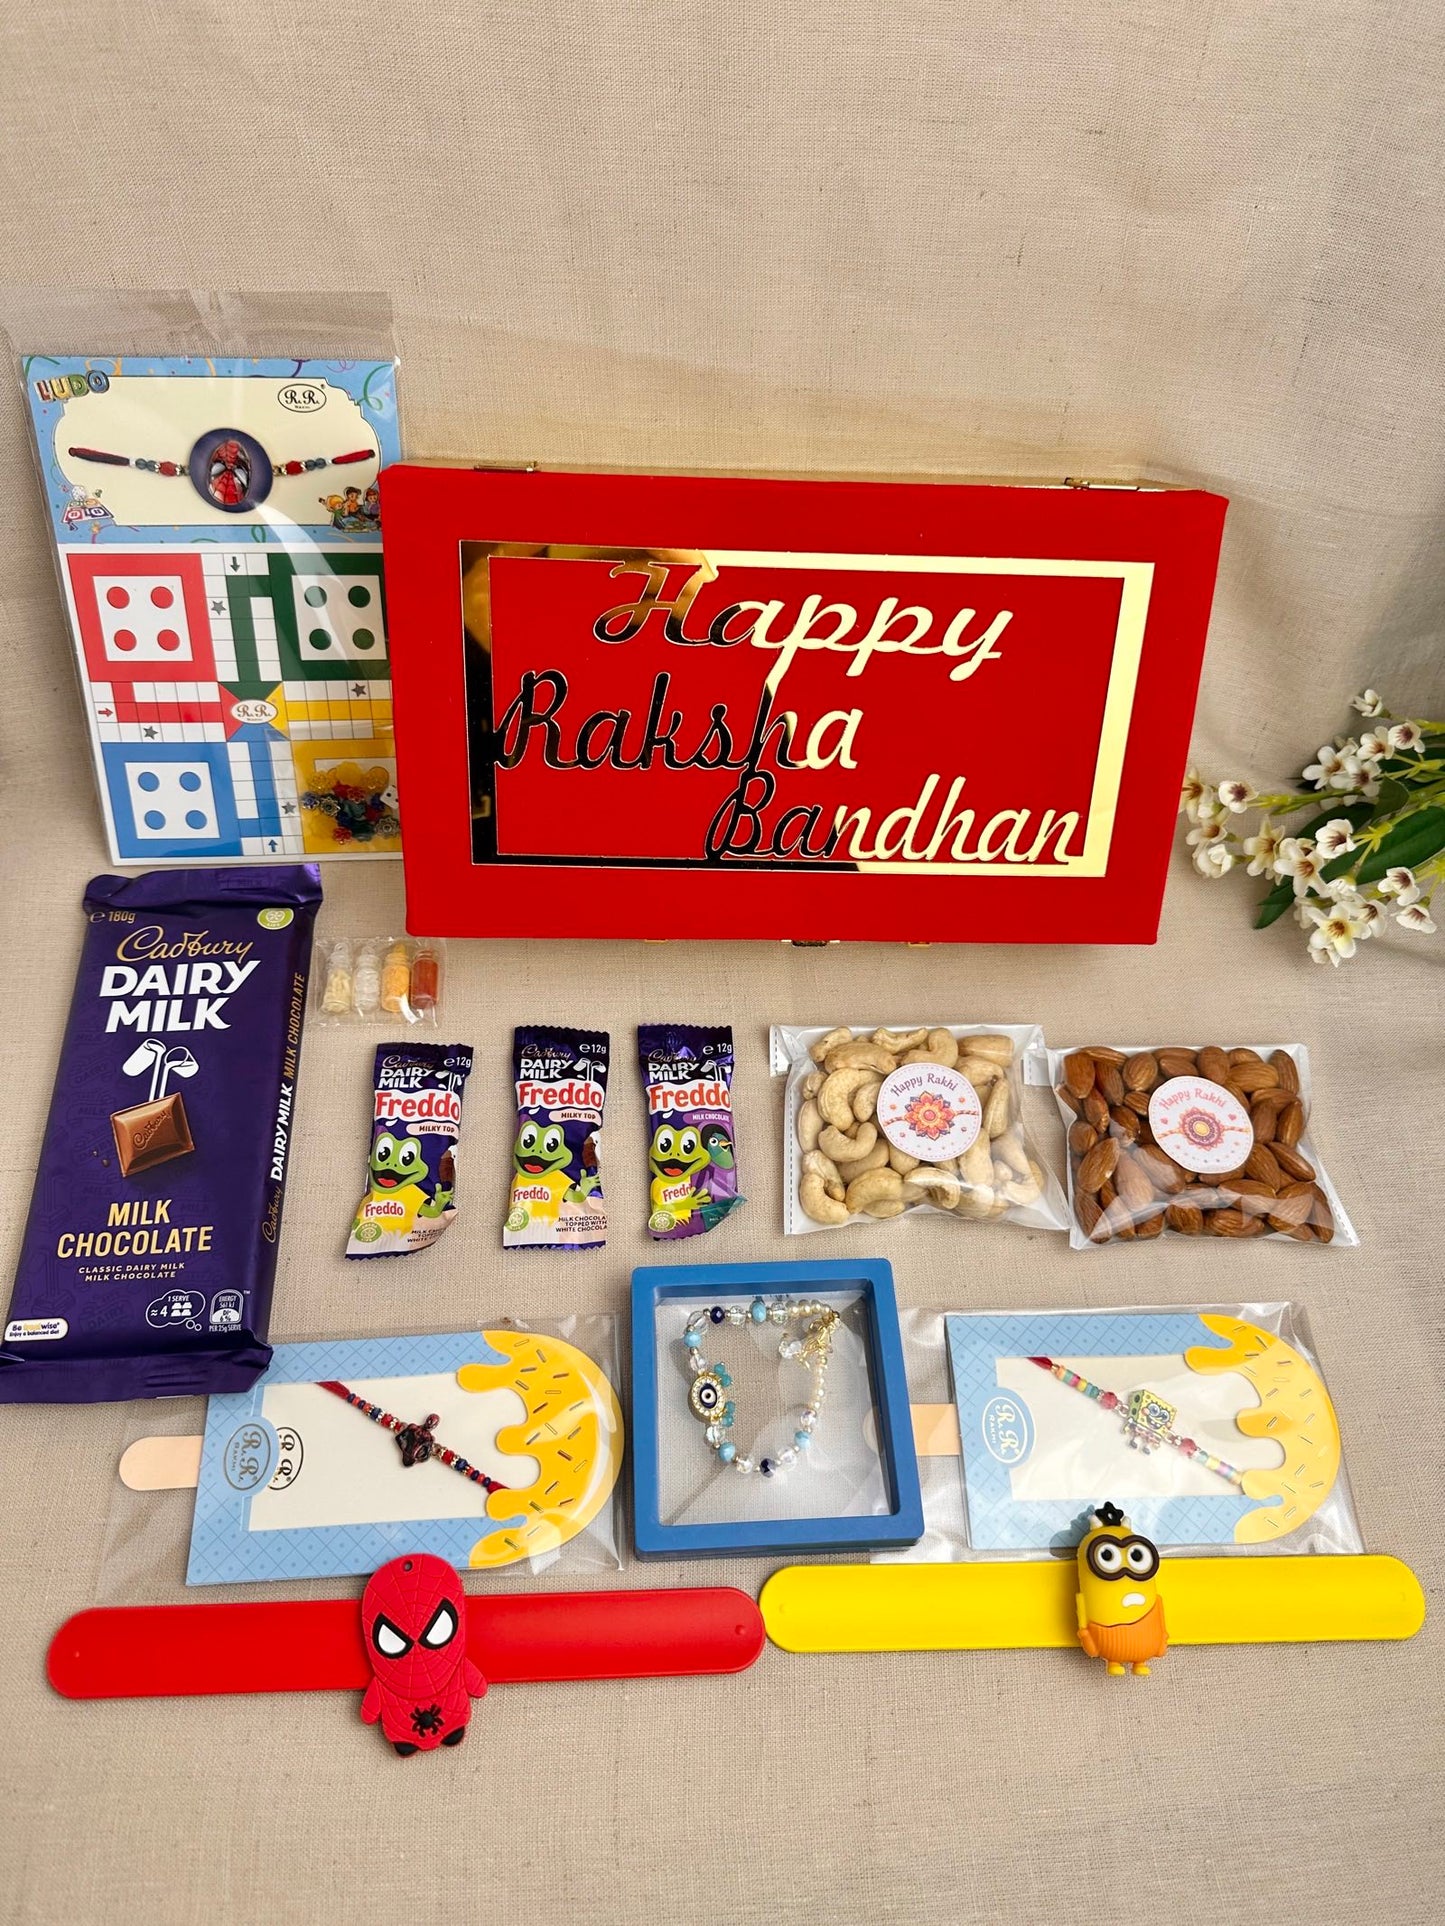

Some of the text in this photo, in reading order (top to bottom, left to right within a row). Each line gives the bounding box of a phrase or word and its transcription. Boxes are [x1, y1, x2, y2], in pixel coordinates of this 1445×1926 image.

[36, 369, 110, 402] LUDO
[593, 562, 1014, 681] Happy
[496, 669, 864, 772] Raksha
[704, 770, 1085, 864] Bandhan
[108, 910, 137, 924] 180g
[116, 925, 254, 964] Cadbury
[99, 960, 262, 997] DAIRY
[105, 997, 232, 1033] MILK
[520, 1043, 572, 1060] Cadbury
[591, 1044, 607, 1054] 12g
[717, 1043, 732, 1054] 12g
[456, 1057, 471, 1068] 12g
[520, 1058, 574, 1069] DAIRY
[648, 1062, 700, 1071] DAIRY
[380, 1067, 435, 1078] DAIRY
[520, 1069, 562, 1079] MILK
[649, 1071, 692, 1083] MILK
[378, 1077, 423, 1088] MILK
[890, 1073, 959, 1096] Happy Rakhi
[519, 1082, 603, 1108] Freddo
[650, 1083, 731, 1110] Freddo
[1159, 1088, 1226, 1110] Happy Rakhi
[262, 972, 305, 1244] Cadbury DAIRY MILK MILK CHOCOLATE
[375, 1092, 460, 1121] Freddo
[513, 1187, 550, 1202] Freddo
[107, 1199, 172, 1226] MILK
[365, 1202, 404, 1217] Freddo
[57, 1226, 214, 1258] CHOCOLATE
[78, 1262, 185, 1274] CLASSIC DAIRY MILK
[114, 1271, 176, 1280] CHOCOLATE
